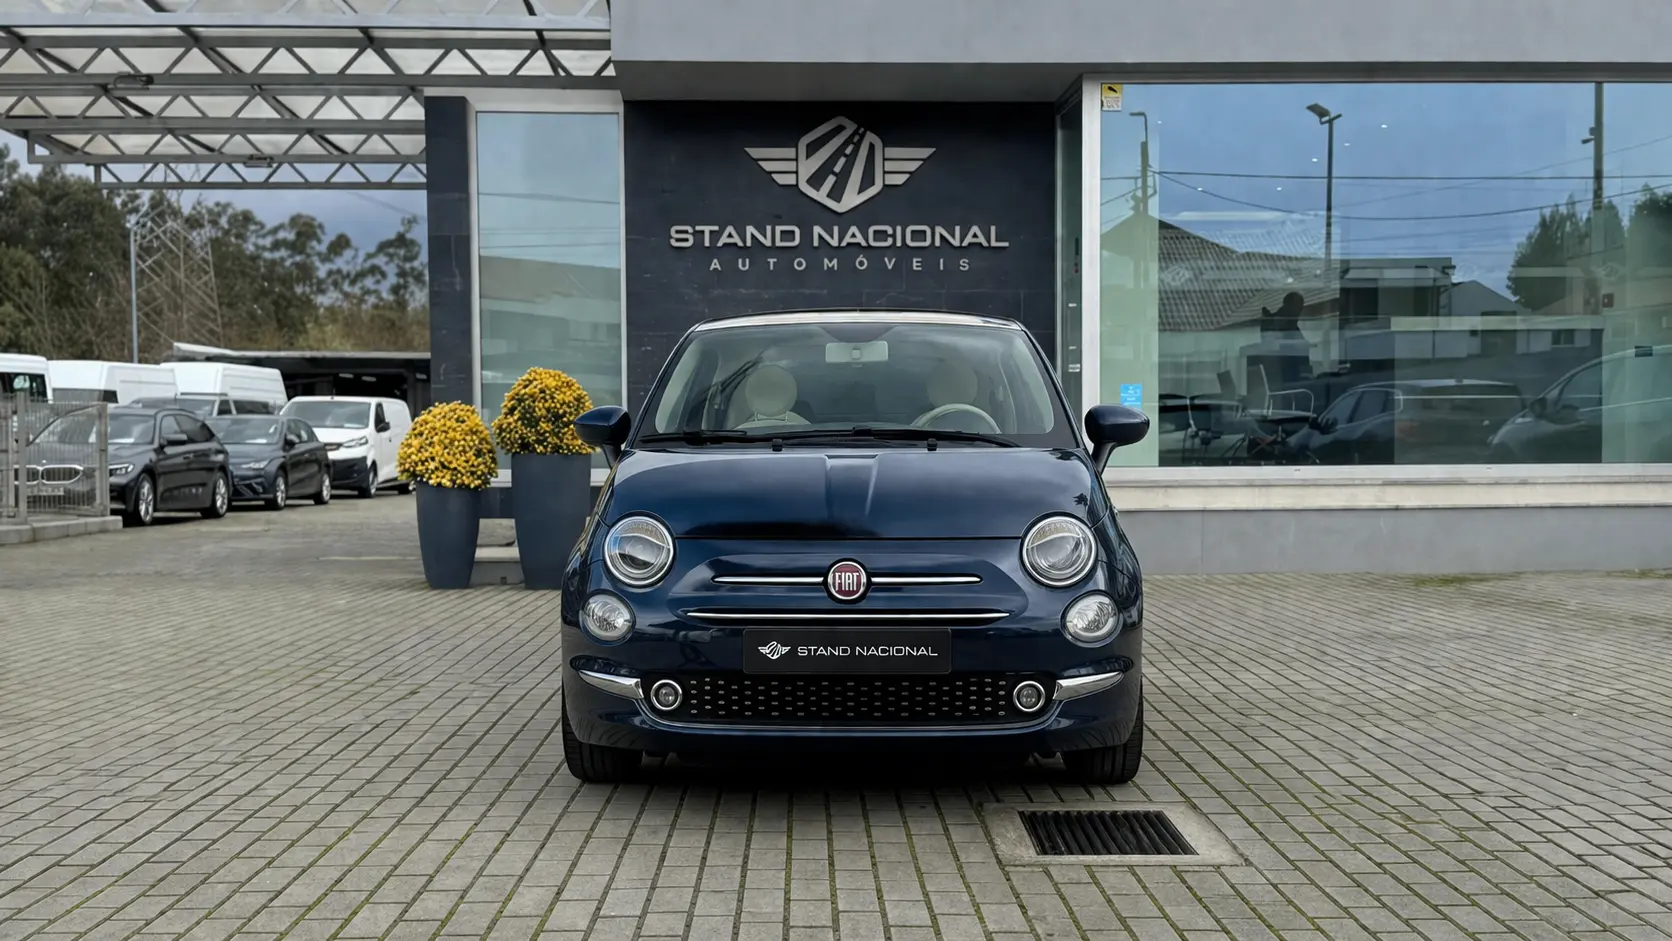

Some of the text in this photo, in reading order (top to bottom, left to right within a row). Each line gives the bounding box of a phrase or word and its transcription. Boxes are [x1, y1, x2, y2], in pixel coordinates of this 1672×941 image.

[669, 225, 1010, 248] STAND NACIONAL
[709, 255, 971, 271] AUTOMÓVEIS
[835, 572, 859, 591] FIAT
[797, 646, 939, 657] STAND NACIONAL
